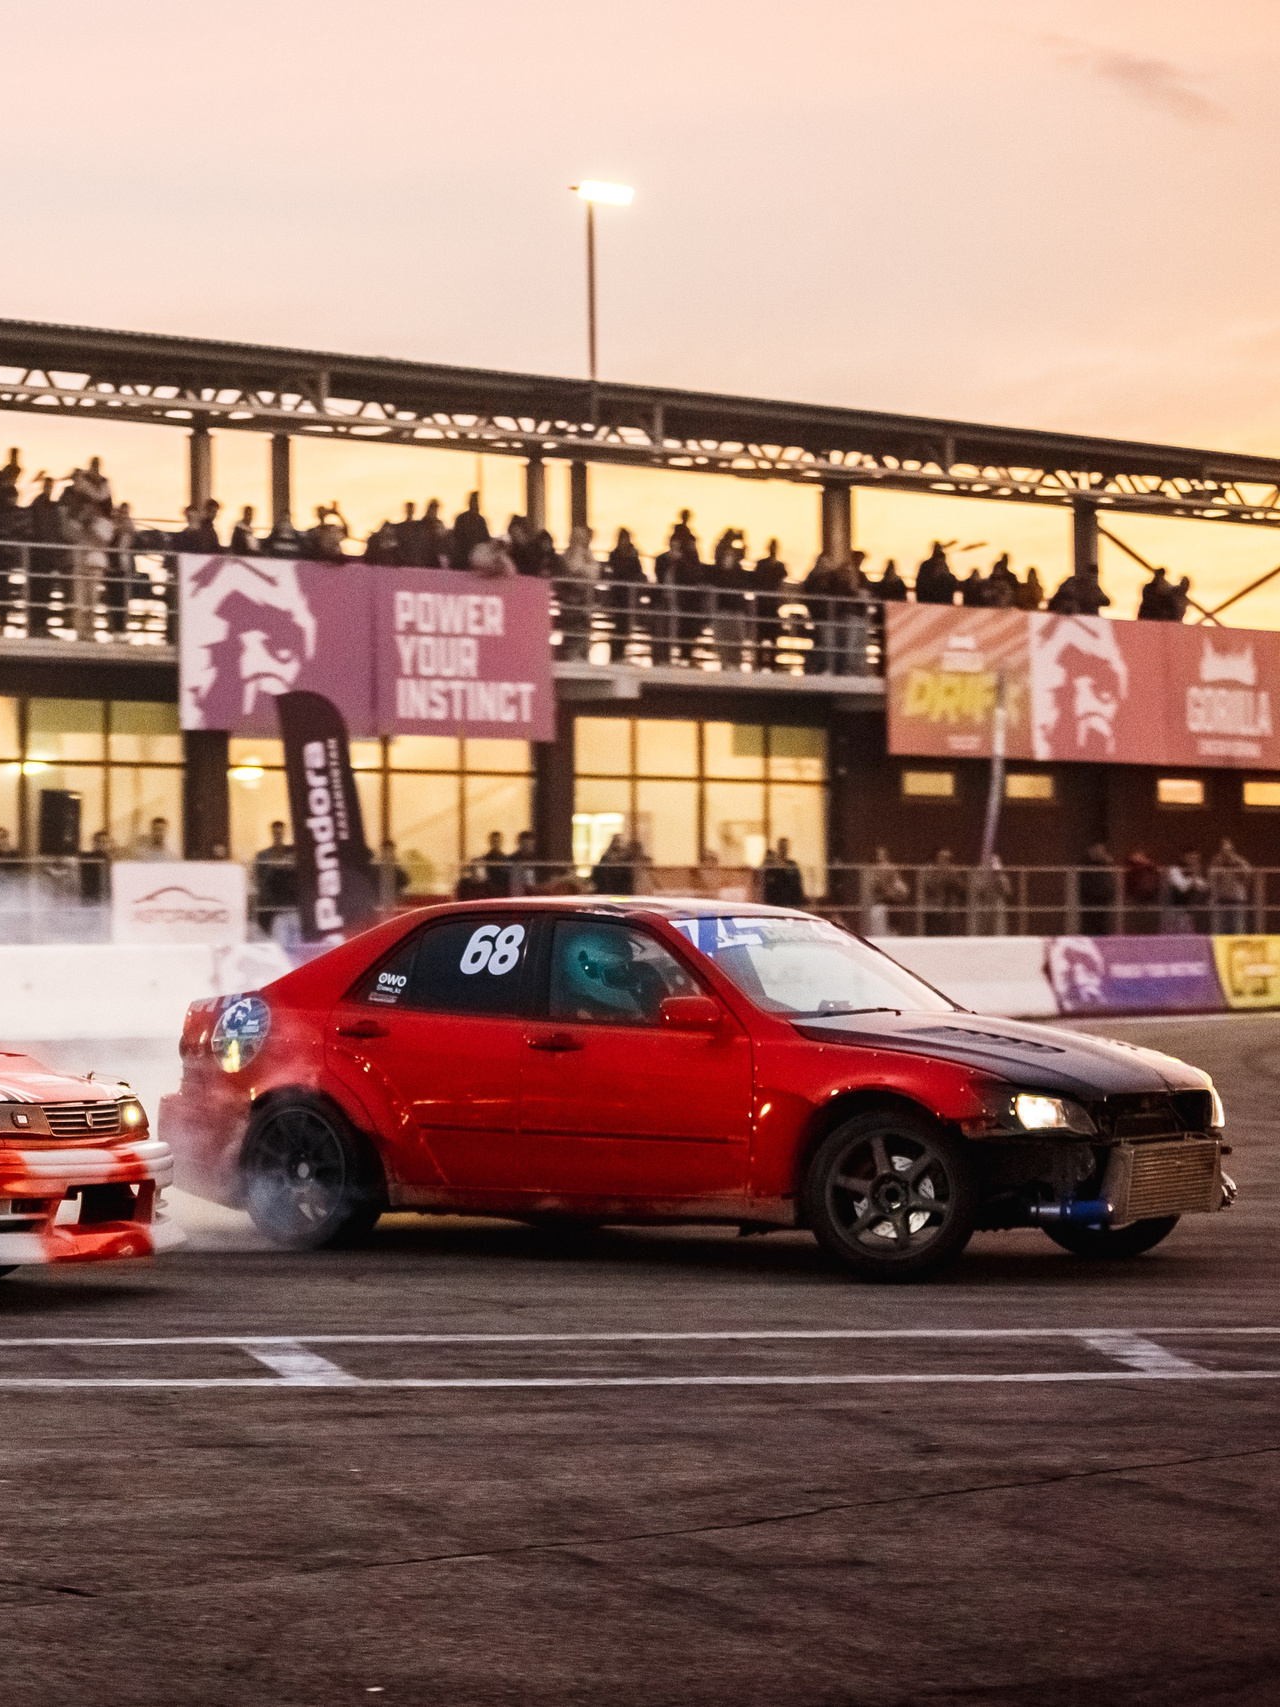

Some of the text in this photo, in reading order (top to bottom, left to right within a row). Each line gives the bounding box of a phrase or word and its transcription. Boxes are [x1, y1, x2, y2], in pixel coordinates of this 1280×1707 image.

[394, 590, 505, 637] POWER
[394, 634, 479, 677] YOUR
[396, 678, 536, 723] INSTINCT
[303, 740, 345, 931] pandora
[460, 924, 525, 976] 68
[378, 972, 407, 988] OWO
